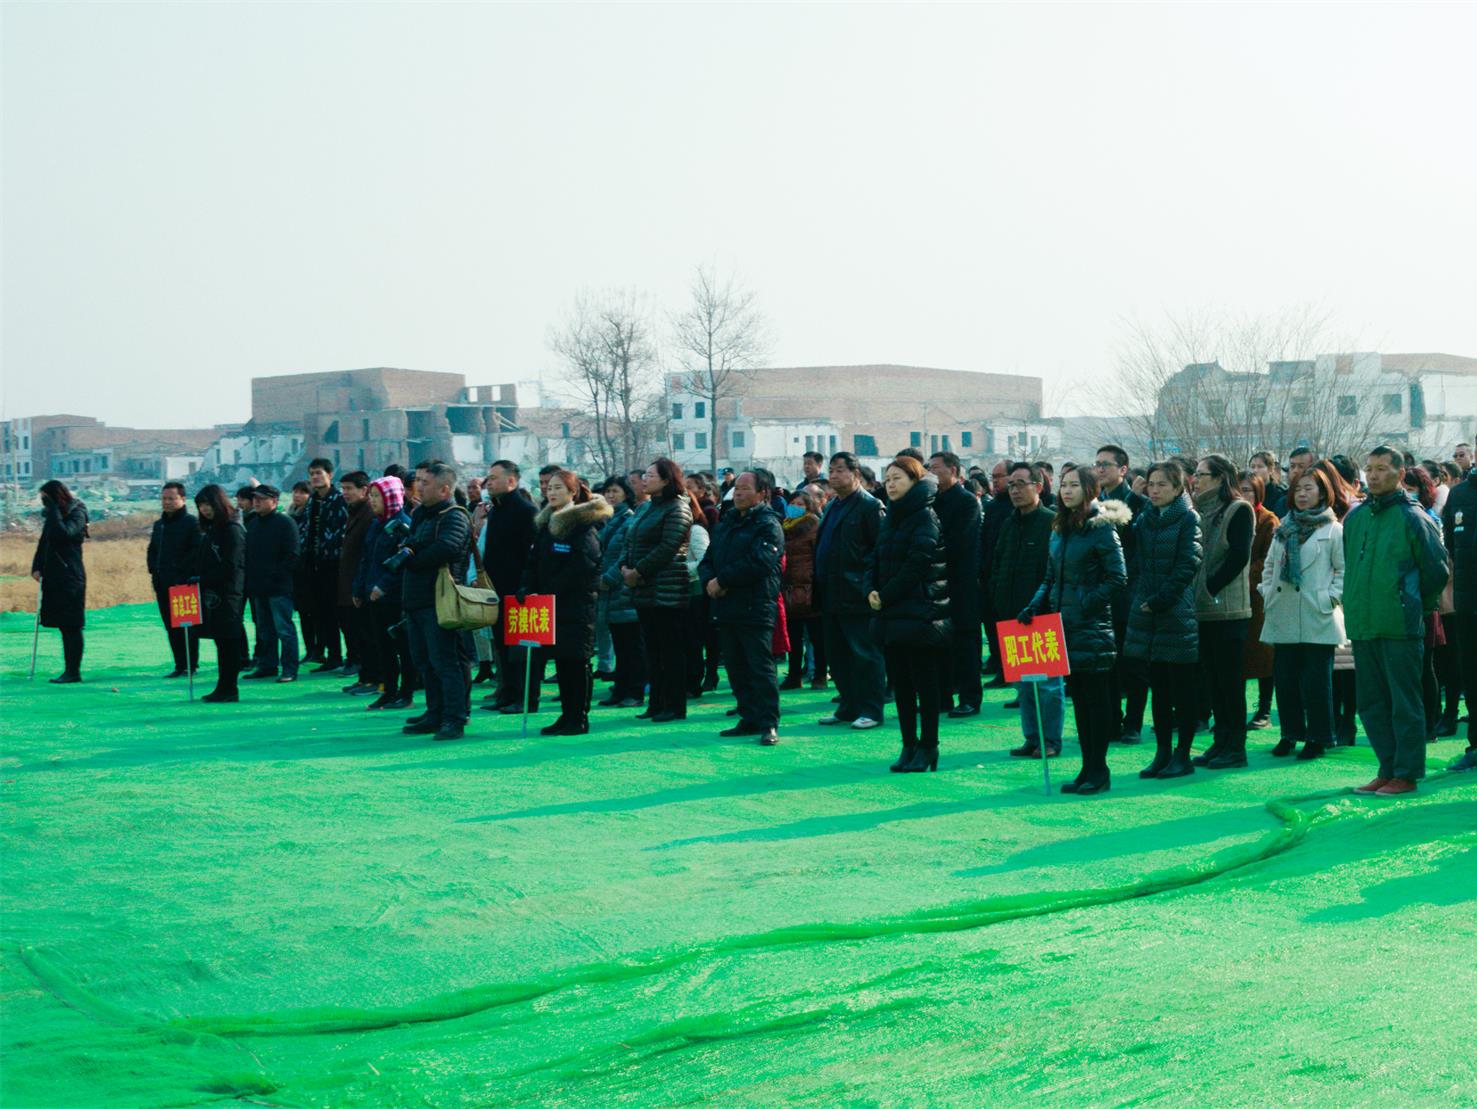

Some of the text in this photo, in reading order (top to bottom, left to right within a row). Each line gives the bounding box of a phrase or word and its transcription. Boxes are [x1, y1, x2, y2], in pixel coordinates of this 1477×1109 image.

[508, 606, 550, 633] 劳模代表
[1003, 628, 1061, 667] 职工代表
